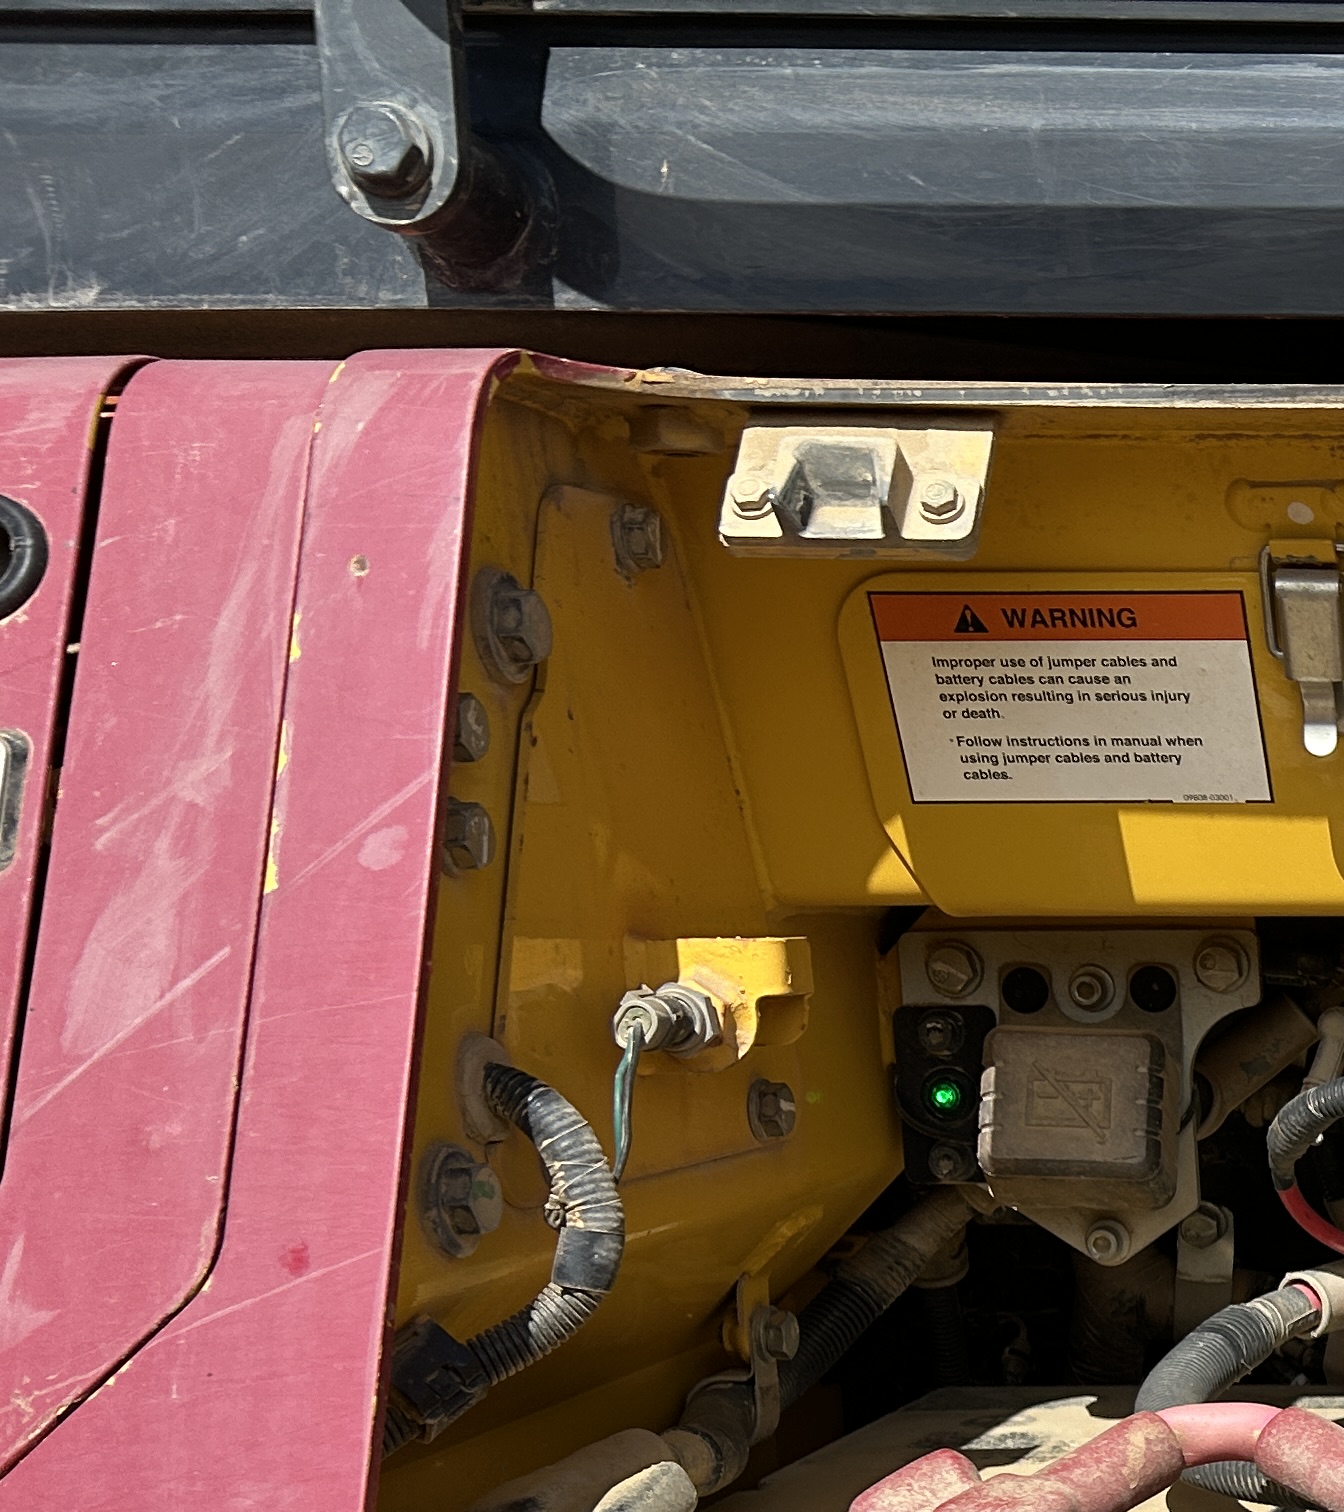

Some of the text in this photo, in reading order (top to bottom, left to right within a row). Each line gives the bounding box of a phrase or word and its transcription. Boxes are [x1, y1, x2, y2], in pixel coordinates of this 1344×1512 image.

[1000, 607, 1138, 629] WARNING
[931, 656, 1178, 670] Improper use of jumper cables and
[934, 673, 1132, 687] battery cables can cause an
[939, 690, 1191, 704] explosion resulting in serious injury
[942, 708, 1005, 719] or death.
[956, 735, 1204, 747] Follow instructions in manual when
[960, 752, 1182, 766] using jumper cables and battery
[963, 769, 1013, 780] cables.
